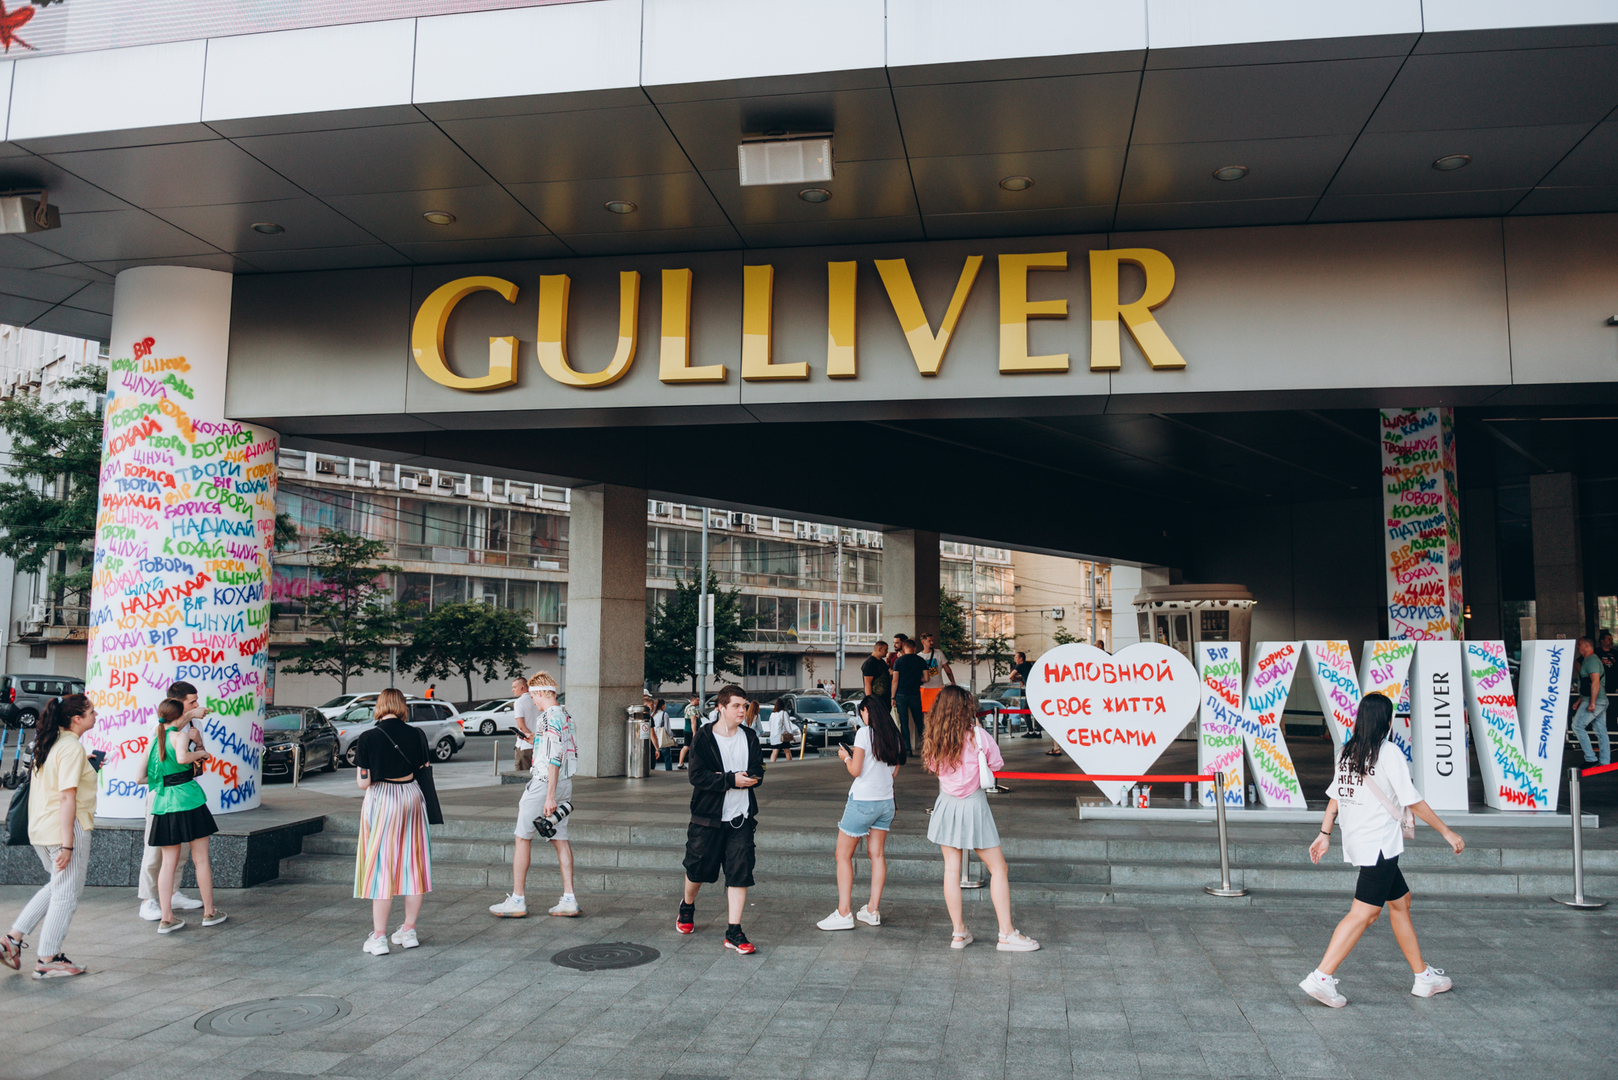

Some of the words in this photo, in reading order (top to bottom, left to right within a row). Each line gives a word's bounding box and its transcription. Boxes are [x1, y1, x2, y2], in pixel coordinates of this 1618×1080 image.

[411, 247, 1187, 392] GULLIVER
[133, 337, 156, 361] ВІР
[112, 358, 138, 373] КОХАЙ
[121, 370, 167, 399] ЦІЛУЙ
[112, 403, 161, 430] ГОВОРИ
[191, 419, 243, 436] КОХАЙ
[1400, 411, 1438, 436] КОХАЙ
[109, 415, 162, 457] КОХАЙ
[191, 430, 254, 459] БОРИСЯ
[133, 449, 174, 466] ЦІНУЙ
[1393, 449, 1438, 465] ТВОРИ
[124, 463, 176, 489] БОРИСЯ
[175, 460, 241, 482] ТВОРИ
[213, 476, 232, 489] ВІР
[1391, 460, 1444, 484] ТВОРИ
[114, 477, 161, 494] ТВОРИ
[164, 483, 191, 505] ВІР
[235, 477, 269, 494] КОХАЙ
[1419, 478, 1437, 492] ВІР
[194, 481, 253, 520] ГОВОРИ
[1400, 489, 1443, 506] ГОВОРИ
[115, 505, 159, 530] ЦІНУЙ
[164, 501, 222, 519] БОРИСЯ
[1392, 503, 1439, 519] КОХАЙ
[101, 525, 136, 541] ТВОРИ
[172, 517, 256, 543] НАДИХАЙ
[109, 536, 149, 560] ЦІЛУЙ
[163, 537, 226, 559] КОХАЙ
[226, 540, 259, 565] ЦІЛУЙ
[1390, 544, 1411, 566] ВІР
[105, 555, 125, 575] ВІР
[138, 556, 194, 576] ГОВОРИ
[203, 559, 245, 573] ТВОРИ
[216, 567, 263, 586] ЦІНУЙ
[1397, 561, 1439, 586] КОХАЙ
[121, 571, 212, 617] НАДИХАЙ
[183, 596, 208, 611] ВІР
[213, 581, 265, 605] КОХАЙ
[116, 604, 184, 630] КОХАЙ
[185, 610, 244, 633] ЦІНУЙ
[1389, 603, 1445, 620] БОРИСЯ
[102, 627, 147, 653] КОХАЙ
[148, 627, 179, 646] ВІР
[192, 632, 239, 649] ЦІЛУЙ
[1326, 640, 1350, 657] ВІР
[107, 644, 159, 669] ЦІНУЙ
[162, 645, 225, 664] ТВОРИ
[1206, 647, 1229, 661] ВІР
[1257, 644, 1295, 671] БОРИСЯ
[1315, 645, 1352, 675] ЦІЛУЙ
[1371, 642, 1415, 666] ТВОРИ
[1468, 644, 1506, 670] БОРИСЯ
[1482, 641, 1504, 658] ВІР
[109, 668, 140, 692] ВІР
[174, 663, 240, 681] БОРИСЯ
[1043, 659, 1174, 684] НАПОВНЮЙ
[1254, 658, 1293, 688] КОХАЙ
[1317, 661, 1359, 701] ГОВОРИ
[1369, 663, 1394, 684] ВІР
[1476, 666, 1510, 690] ТВОРИ
[217, 671, 259, 699] БОРИСЯ
[1203, 674, 1241, 709] КОХАЙ
[1248, 680, 1289, 714] ЦІЛУЙ
[206, 692, 255, 717] КОХАЙ
[1040, 696, 1092, 717] СВОЄ
[1102, 695, 1167, 715] ЖИТТЯ
[1202, 722, 1236, 735] ТВОРИ
[1206, 695, 1279, 743] ПІДТРИМУЙ
[1257, 712, 1276, 726] ВІР
[1432, 671, 1454, 778] GULLIVER
[203, 717, 260, 771] НАДИХАЙ
[1066, 728, 1157, 747] СЕНСАМИ
[1203, 733, 1242, 748] ГОВОРИ
[1494, 746, 1548, 806] НАДИХАЙ
[220, 774, 256, 809] КОХАЙ
[1260, 776, 1291, 804] ЦІЛУЙ
